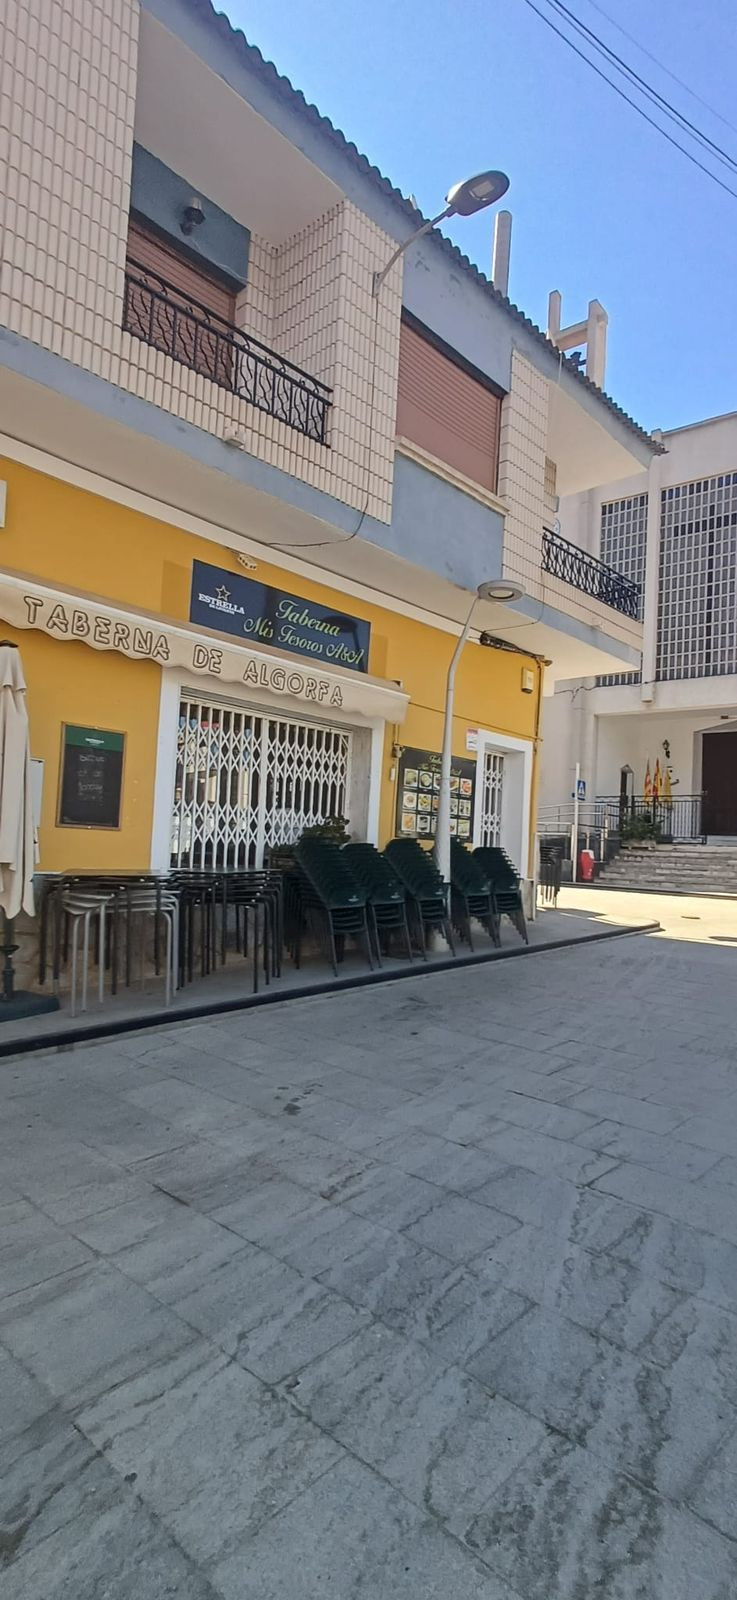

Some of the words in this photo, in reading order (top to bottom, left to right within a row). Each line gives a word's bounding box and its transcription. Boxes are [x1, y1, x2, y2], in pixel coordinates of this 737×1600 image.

[198, 593, 245, 615] ESTRELLA
[275, 599, 341, 637] Taberna
[23, 596, 170, 661] TABERNA
[192, 644, 223, 674] DE
[243, 660, 343, 707] ALGORFA
[243, 617, 274, 639] Mis
[278, 624, 323, 654] Tesoros
[326, 642, 365, 665] A&A
